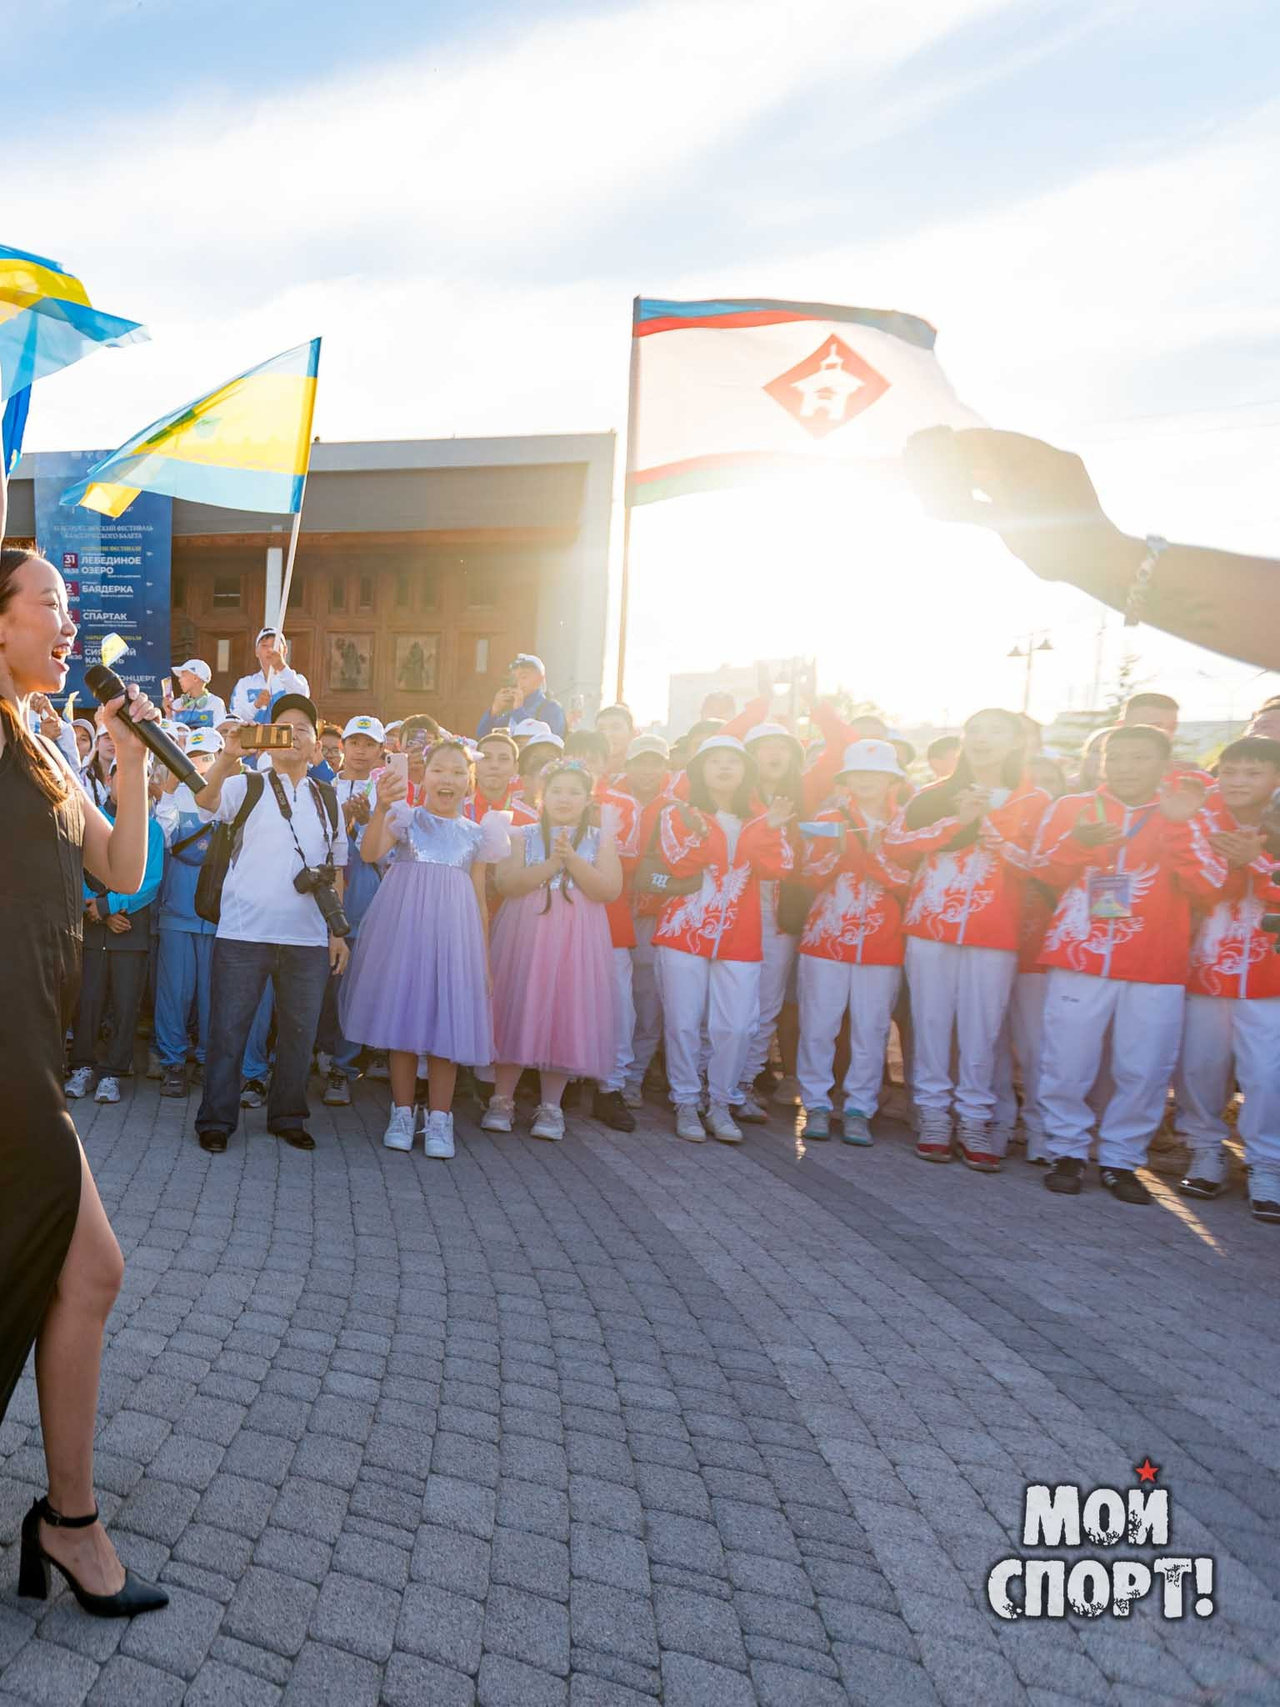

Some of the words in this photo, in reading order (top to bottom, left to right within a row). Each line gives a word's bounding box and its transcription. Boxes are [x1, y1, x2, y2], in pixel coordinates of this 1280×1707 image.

[64, 554, 76, 564] 31
[81, 556, 141, 565] ЛЕБЕДИНОЕ
[81, 566, 114, 574] ОЗЕРО
[82, 585, 134, 594] БАЯДЕРКА
[83, 612, 127, 621] СПАРТАК
[119, 674, 156, 682] ОНЦЕРТ
